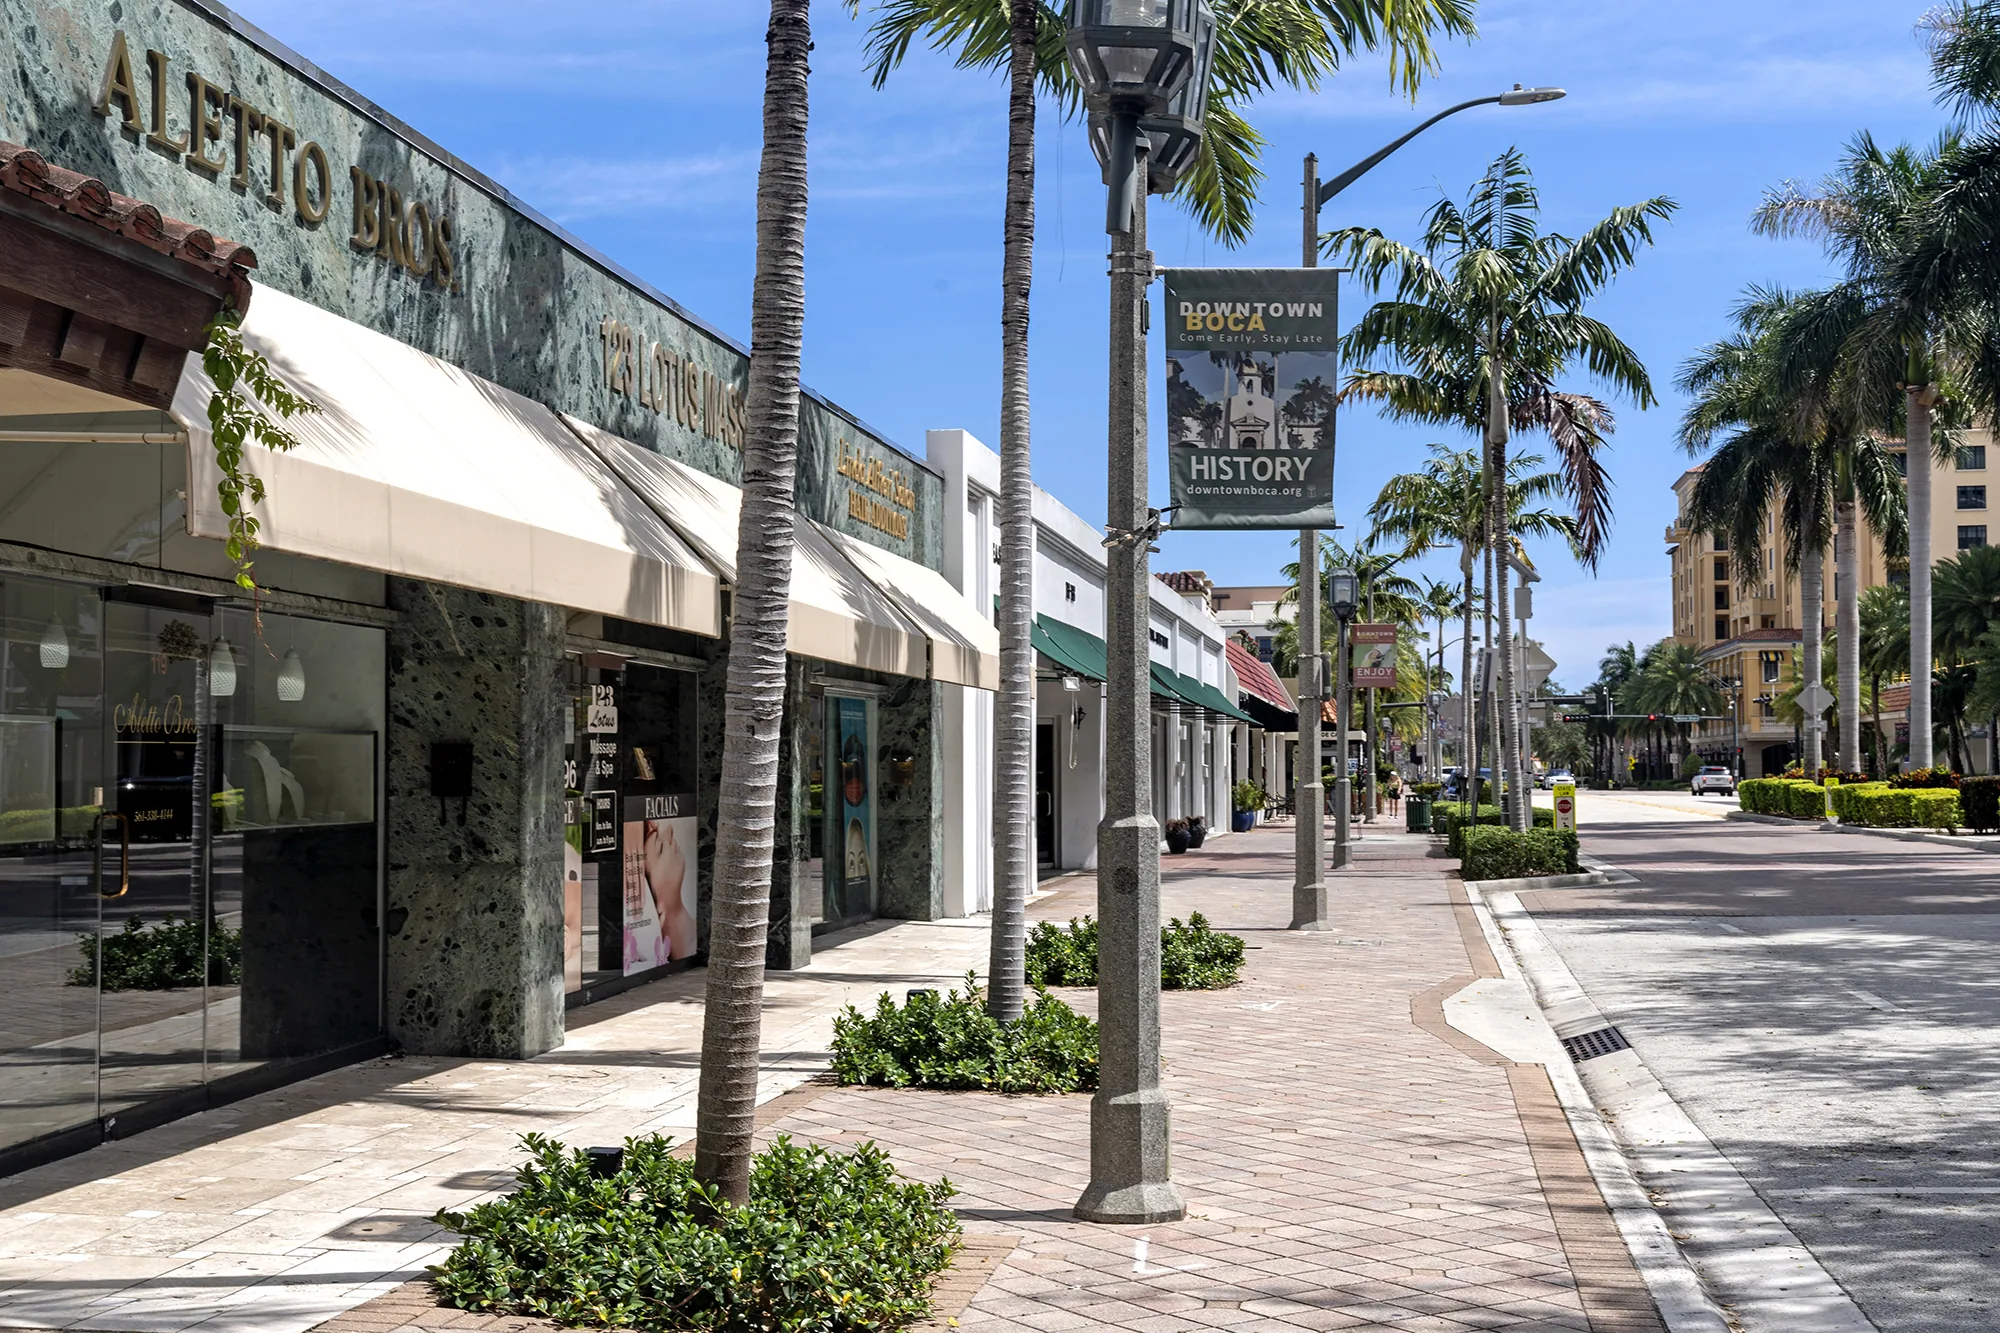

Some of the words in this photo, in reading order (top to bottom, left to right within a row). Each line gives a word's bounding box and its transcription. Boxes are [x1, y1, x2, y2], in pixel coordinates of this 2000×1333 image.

[92, 30, 332, 224] ALETTO
[1179, 302, 1323, 317] DOWNTOWN
[1186, 312, 1266, 331] BOCA
[1180, 333, 1213, 342] Come
[1219, 333, 1256, 344] Early,
[1263, 334, 1289, 344] Stay
[1296, 334, 1323, 342] Late
[600, 318, 634, 397] 123
[639, 334, 700, 431] LOTUS
[1191, 455, 1312, 482] HISTORY
[1187, 484, 1302, 497] downtownboca.org
[1357, 668, 1393, 676] ENJOY
[590, 684, 615, 707] 123
[589, 709, 615, 728] Lotus
[590, 739, 617, 757] Massage
[595, 760, 601, 775] &
[601, 760, 614, 778] Spa
[645, 796, 679, 818] FACIALS
